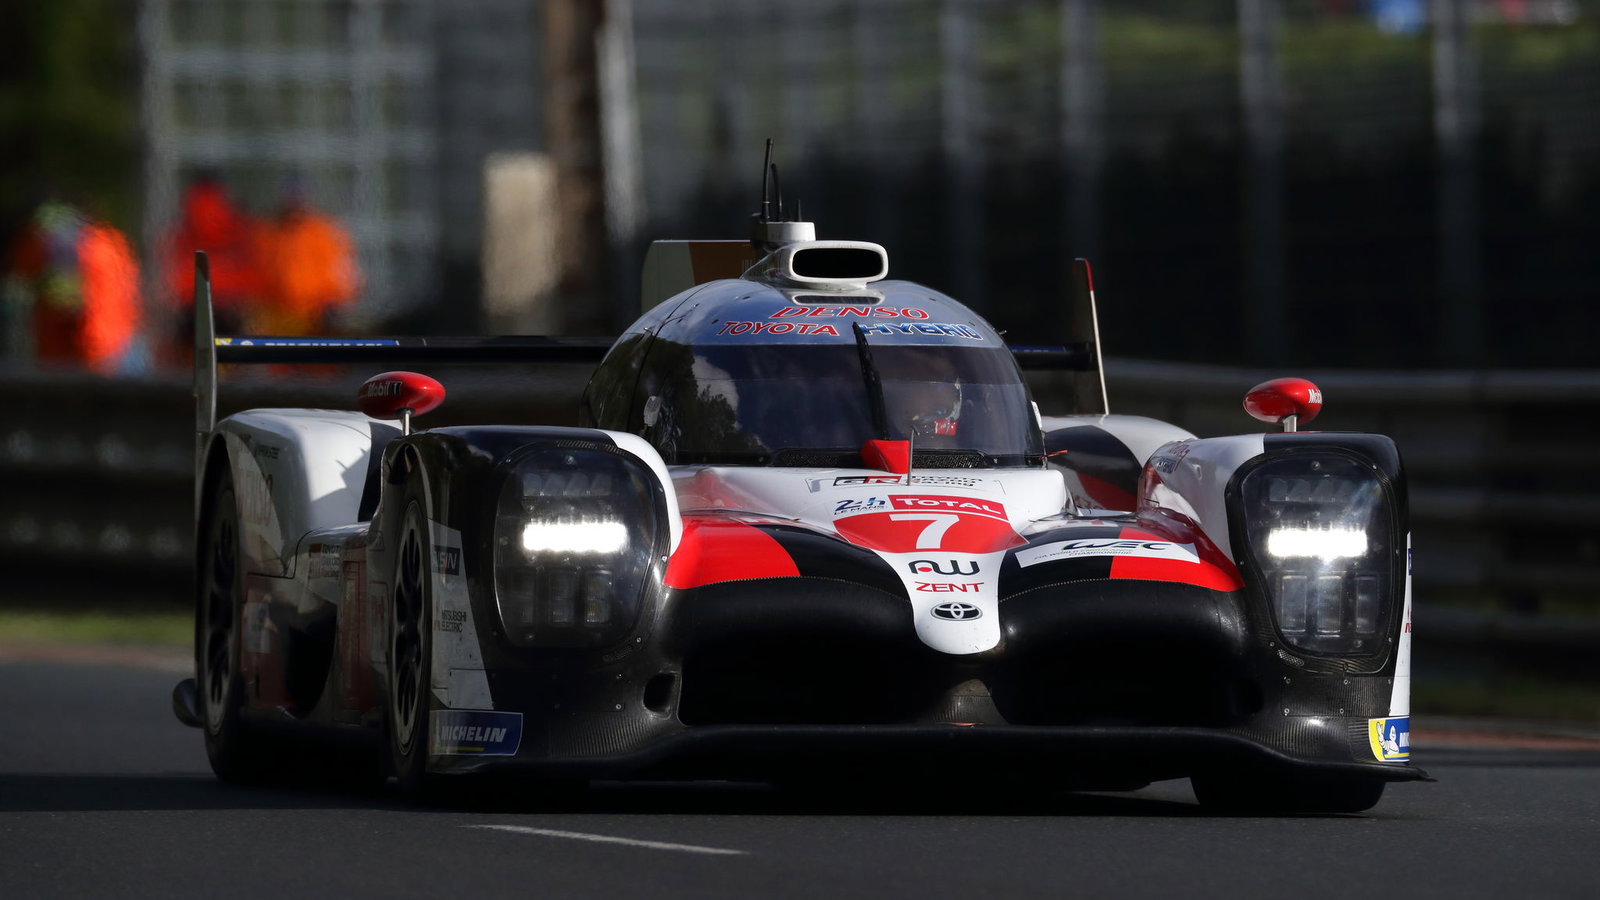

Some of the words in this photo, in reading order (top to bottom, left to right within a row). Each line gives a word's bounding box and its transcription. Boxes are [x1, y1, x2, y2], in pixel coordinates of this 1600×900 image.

[768, 306, 929, 319] DENSO
[716, 321, 840, 336] TOYOTA
[858, 322, 984, 341] HYBRID
[367, 381, 391, 398] Mobil
[834, 476, 901, 487] GR
[895, 498, 1002, 515] TOTAL
[889, 513, 959, 550] 7
[914, 581, 985, 593] ZENT
[440, 726, 507, 743] MICHELIN
